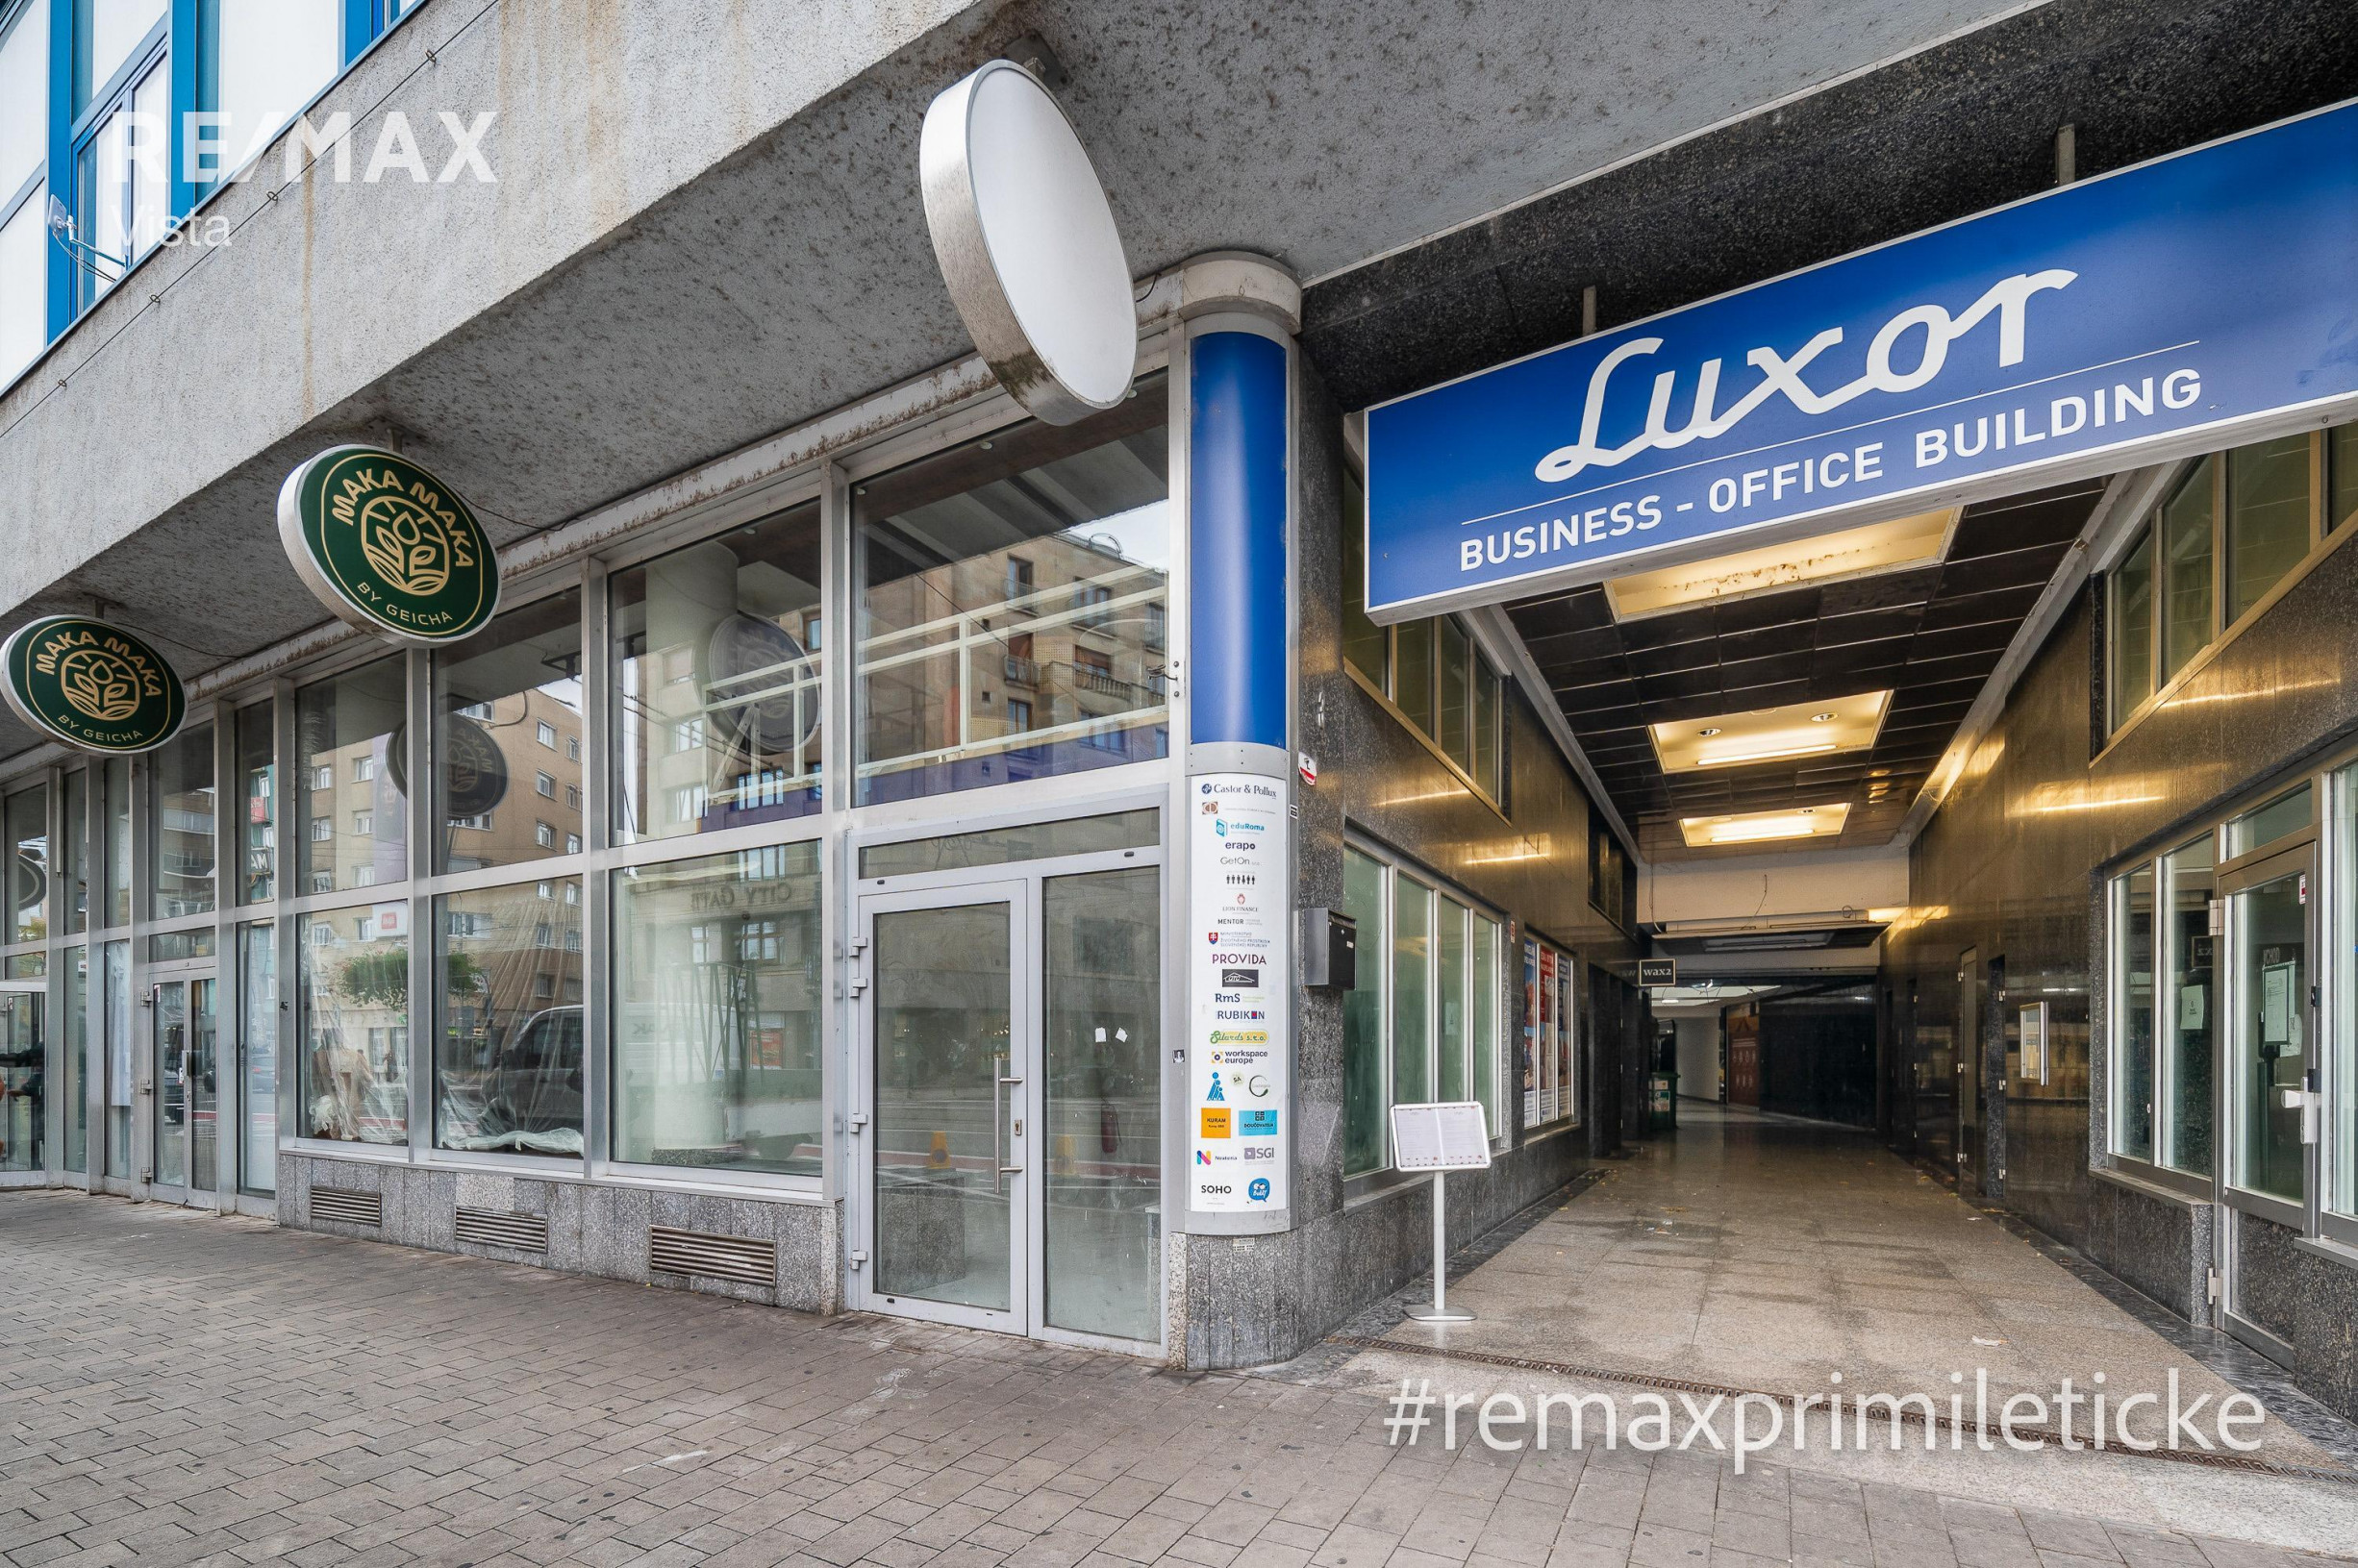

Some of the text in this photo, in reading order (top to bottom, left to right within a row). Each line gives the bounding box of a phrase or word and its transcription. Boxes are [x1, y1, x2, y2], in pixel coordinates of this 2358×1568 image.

[1536, 268, 2077, 484] Luxor
[1460, 494, 1662, 573] BUSINESS
[1708, 440, 1884, 514] OFFICE
[1915, 368, 2203, 469] BUILDING
[332, 467, 474, 567] MAKA MAKA
[357, 582, 453, 625] BY GEICHA
[36, 631, 163, 696] MAKA MAKA
[58, 714, 143, 742] BY GEICHA
[1214, 784, 1277, 798] Castor & Pollux
[1230, 822, 1265, 832] eduRoma
[1220, 857, 1250, 865] GetOn
[1212, 953, 1267, 964] PROVIDA
[1643, 968, 1672, 977] wax2
[1215, 993, 1241, 1003] RmS
[1256, 1147, 1274, 1159] SGI
[1201, 1184, 1232, 1194] SOHO
